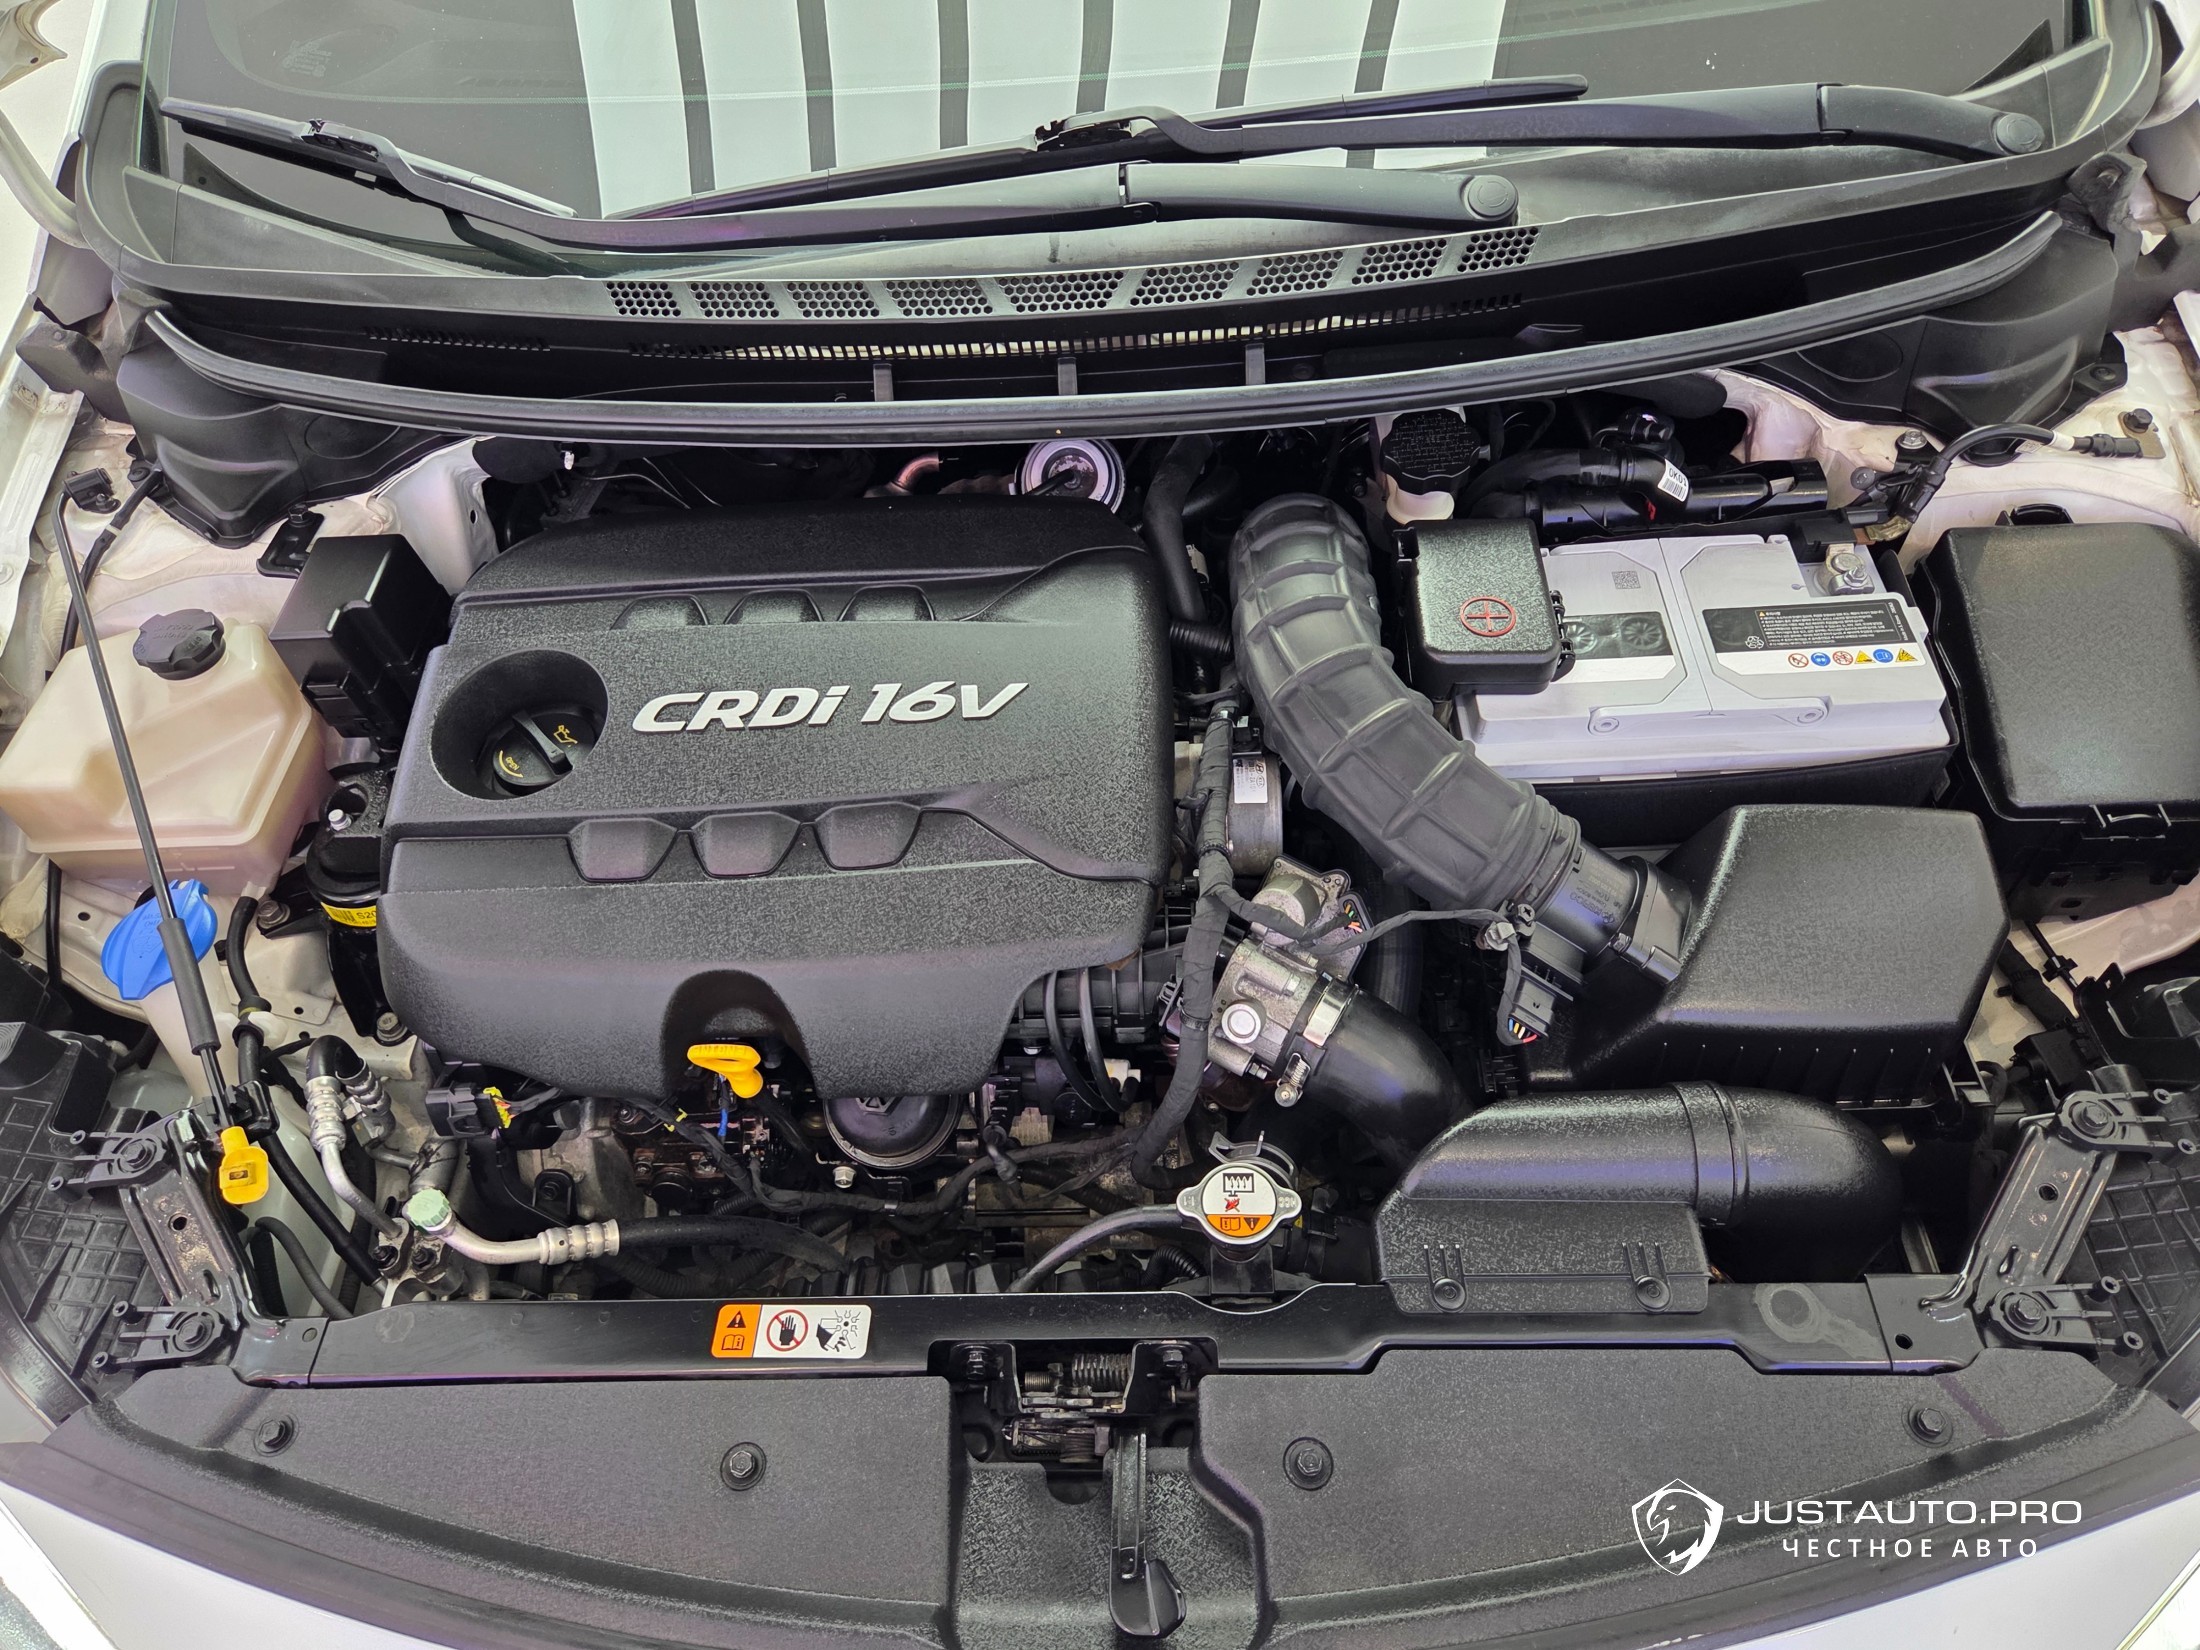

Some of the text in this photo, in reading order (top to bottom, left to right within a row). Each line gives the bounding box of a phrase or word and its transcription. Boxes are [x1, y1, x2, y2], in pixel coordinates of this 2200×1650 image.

[632, 681, 1030, 732] CRDi 16V
[505, 756, 521, 771] OPEN
